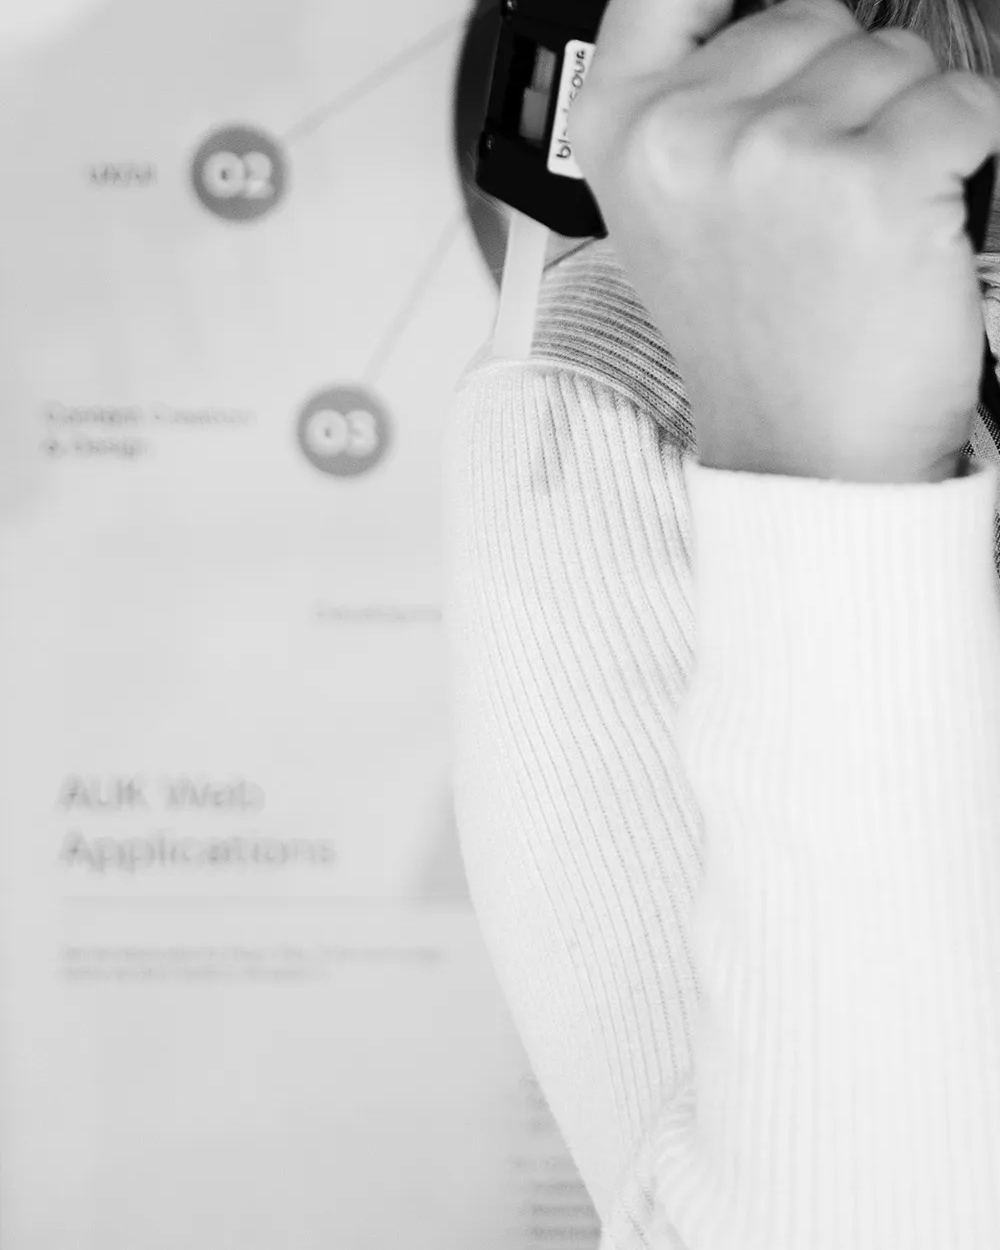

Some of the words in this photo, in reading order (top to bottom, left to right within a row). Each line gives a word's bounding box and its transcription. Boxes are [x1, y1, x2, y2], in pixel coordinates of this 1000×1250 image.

[202, 150, 275, 200] 02
[306, 408, 378, 457] 03
[55, 771, 150, 811] AUK
[157, 771, 265, 813] Web
[56, 829, 338, 873] Applications
